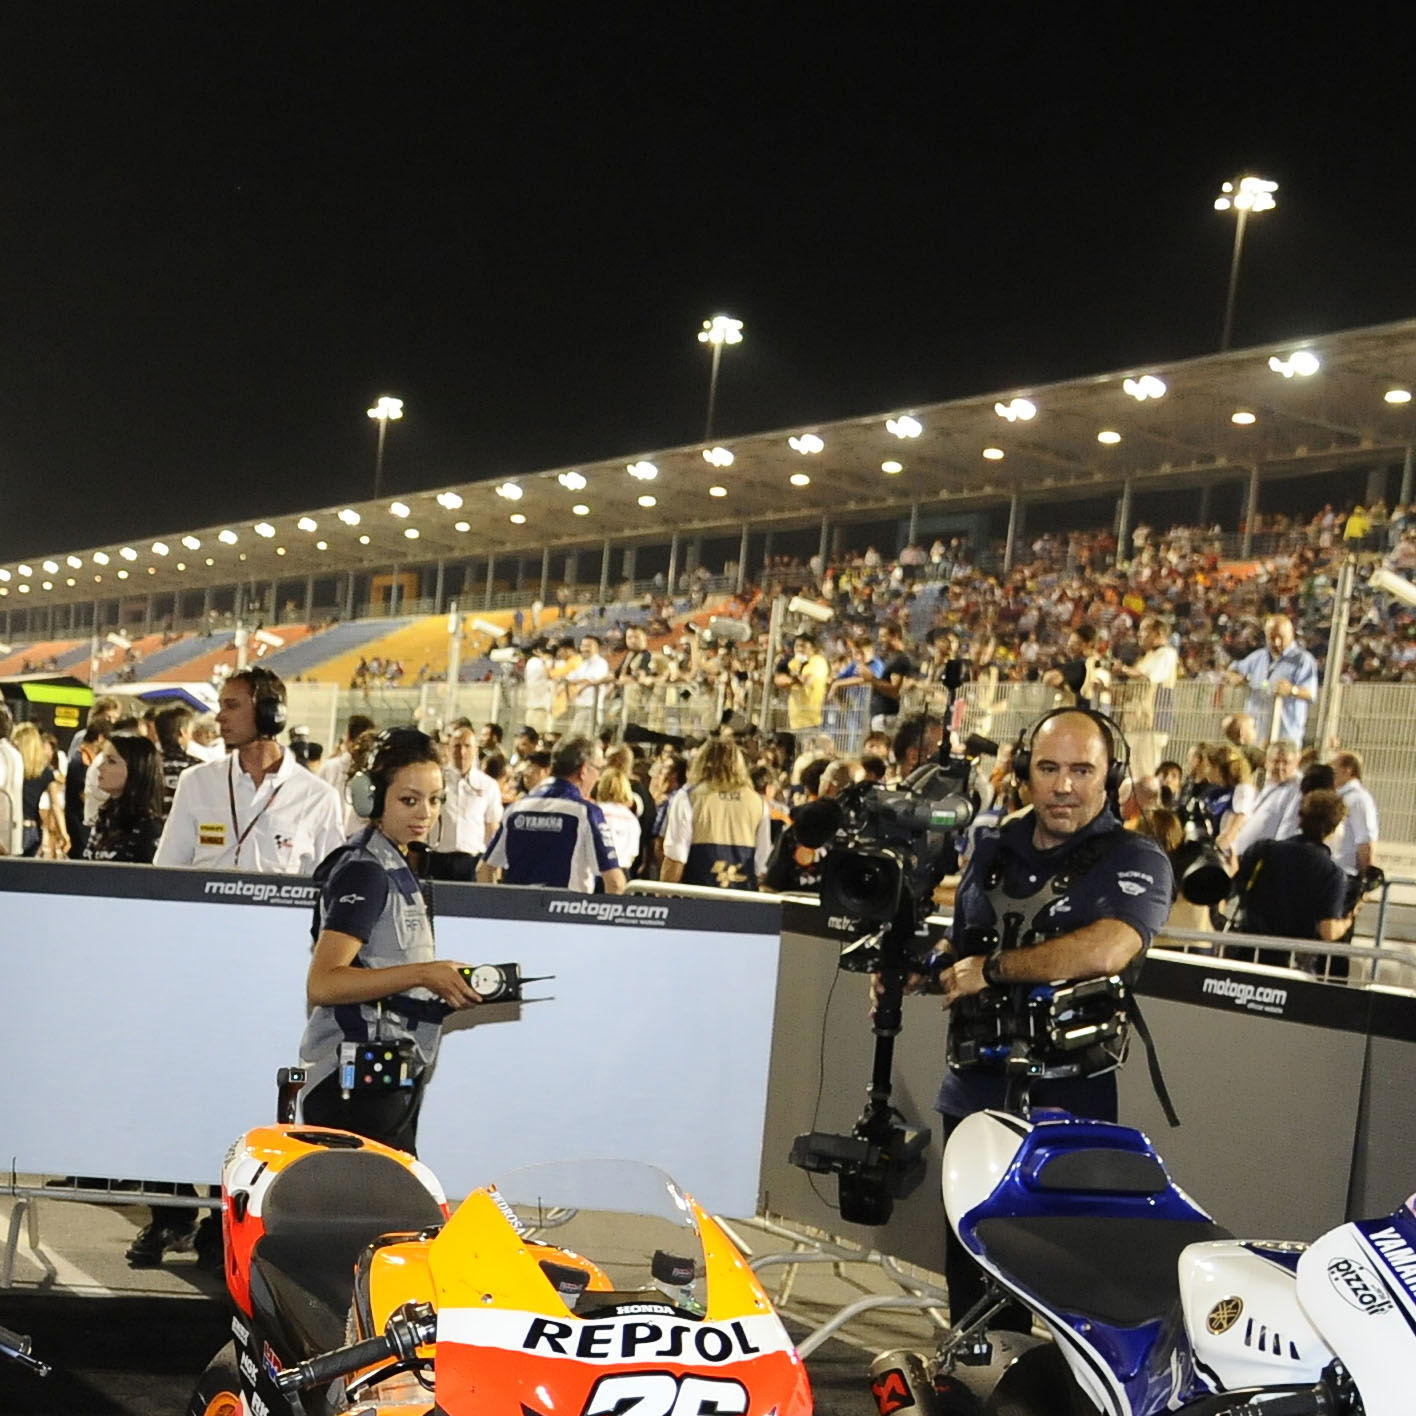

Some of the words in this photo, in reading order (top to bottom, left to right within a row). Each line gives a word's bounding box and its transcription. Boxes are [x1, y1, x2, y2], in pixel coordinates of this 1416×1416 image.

[526, 815, 563, 829] YAMAHA
[548, 899, 669, 920] motogp.com
[1202, 977, 1288, 1005] motogp.com
[489, 1189, 526, 1236] PEDROSA
[615, 1304, 676, 1316] HONDA
[522, 1317, 761, 1363] REPSOL
